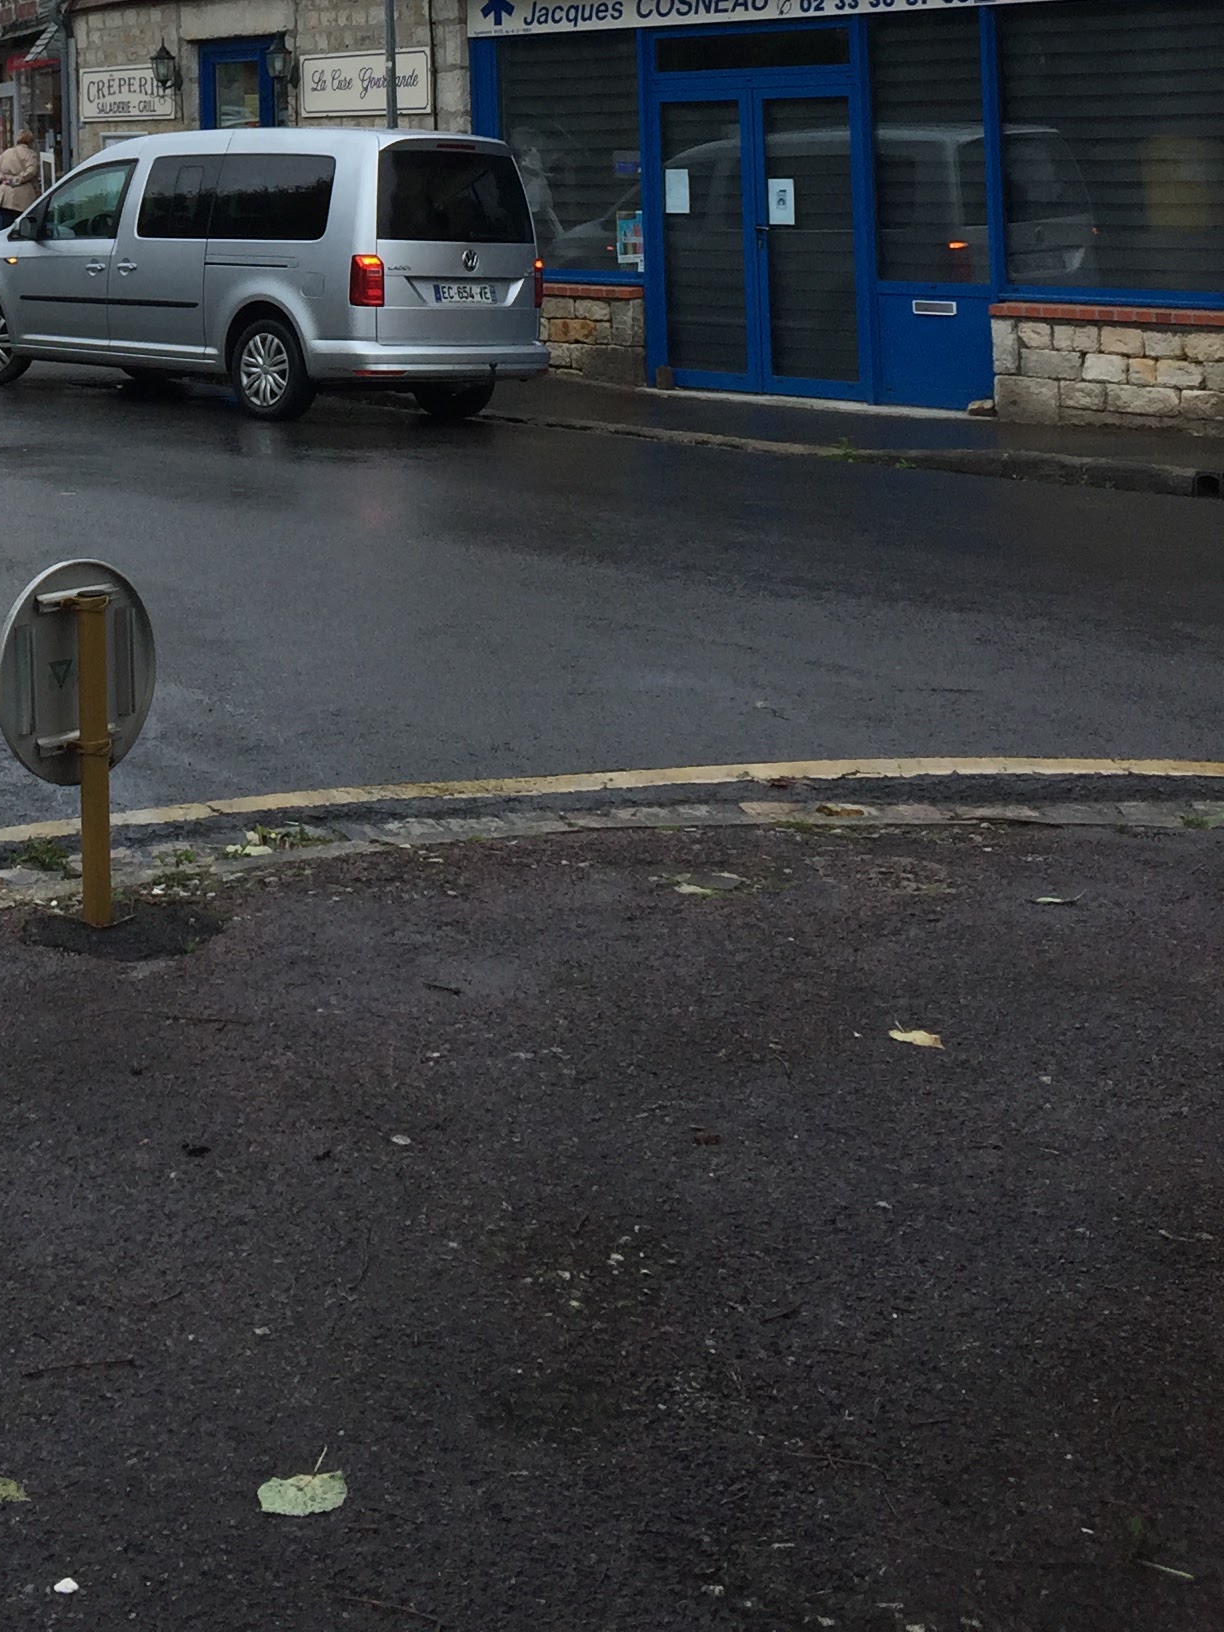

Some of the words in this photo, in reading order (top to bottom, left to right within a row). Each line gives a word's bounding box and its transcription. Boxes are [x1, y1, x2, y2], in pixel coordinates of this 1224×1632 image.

[523, 0, 624, 28] Jacques
[311, 69, 327, 92] La
[331, 68, 353, 91] Cure
[358, 67, 419, 99] Gourande
